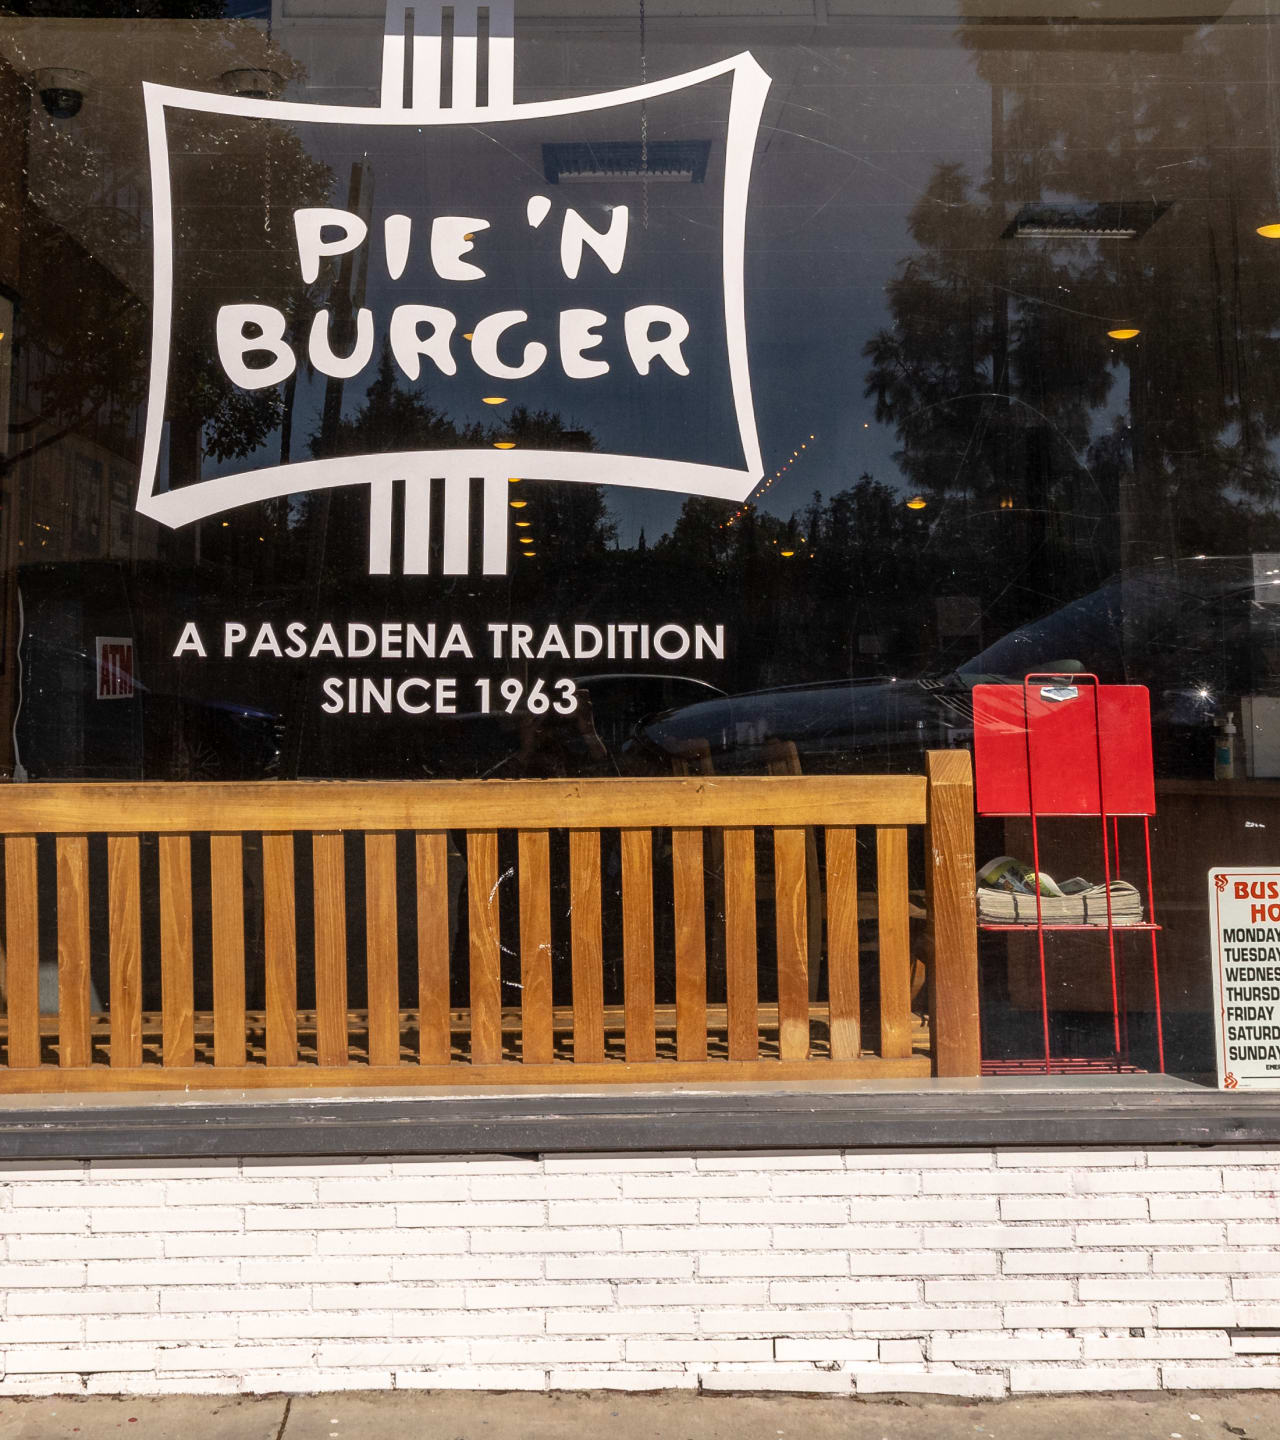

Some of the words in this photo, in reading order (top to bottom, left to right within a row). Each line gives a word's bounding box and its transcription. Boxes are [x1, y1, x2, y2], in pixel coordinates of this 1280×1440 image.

[293, 207, 491, 284] PIE
[526, 195, 629, 280] 'N
[216, 303, 690, 390] BURGER
[172, 622, 207, 657] A
[224, 622, 474, 658] PASADENA
[488, 624, 724, 660] TRADITION
[99, 644, 133, 696] ATM
[321, 677, 456, 715] SINCE
[475, 678, 578, 715] 1963
[1226, 1006, 1274, 1021] FRIDAY
